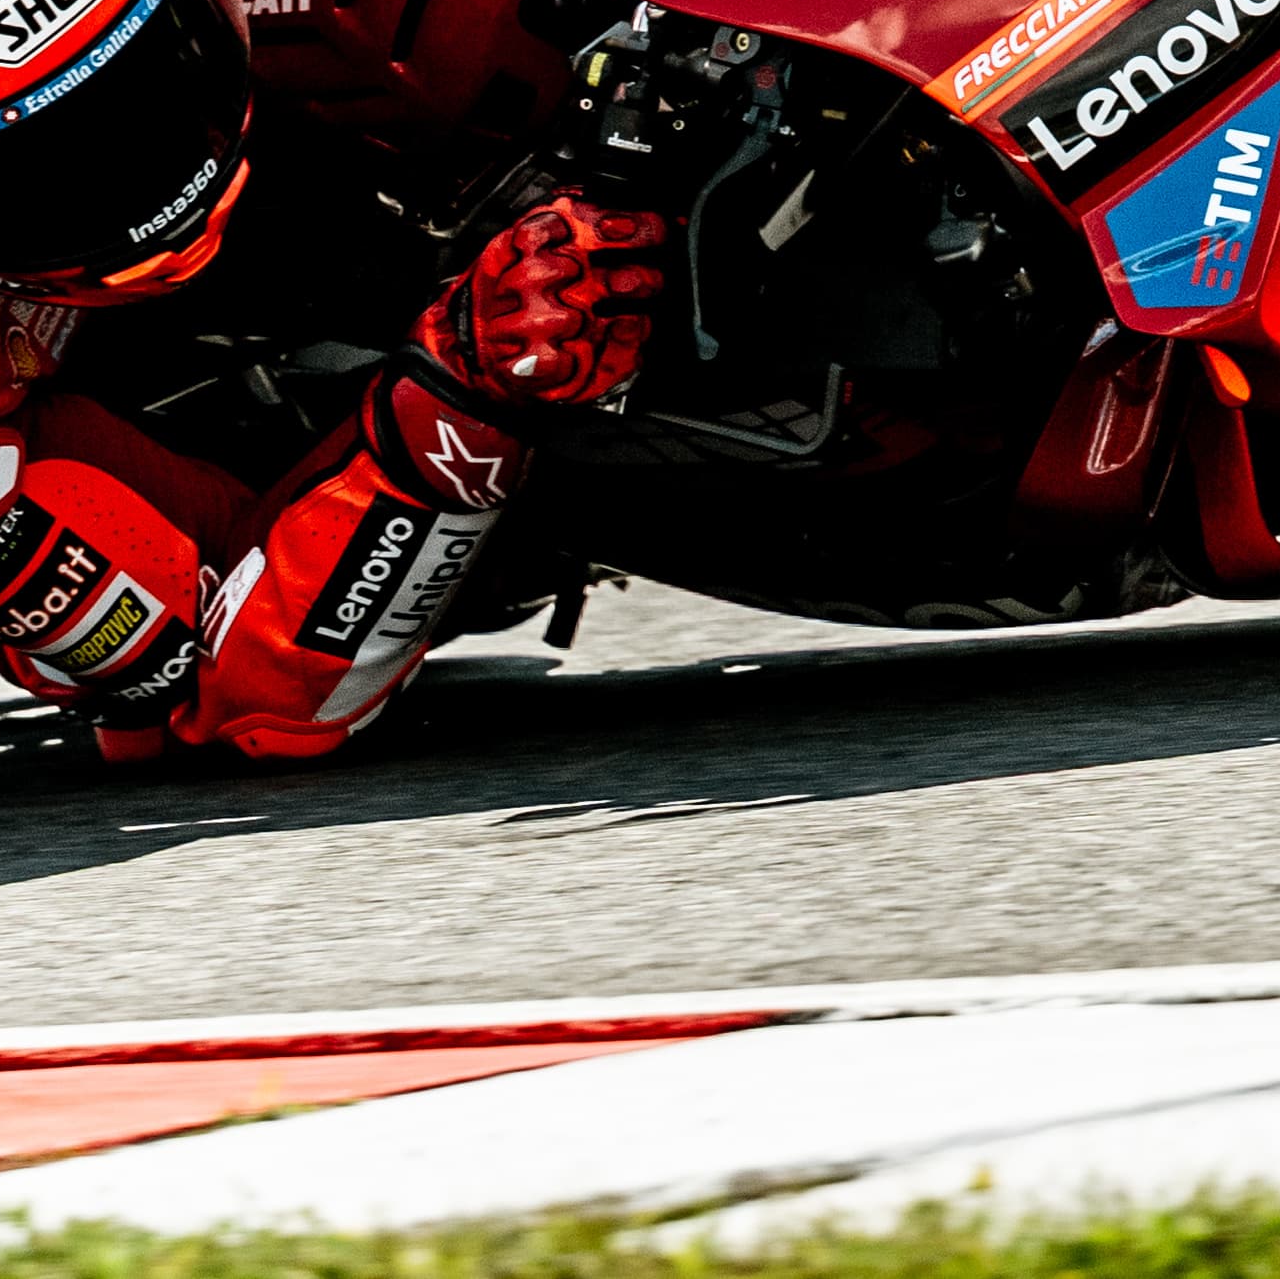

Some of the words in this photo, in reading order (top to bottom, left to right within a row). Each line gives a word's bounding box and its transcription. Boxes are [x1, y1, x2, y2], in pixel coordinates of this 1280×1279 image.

[24, 64, 93, 115] Estrella
[89, 14, 144, 67] Galicia
[127, 157, 219, 244] Insta360
[1202, 127, 1272, 228] TIM
[314, 514, 415, 643] Lenovo
[377, 526, 484, 640] Unipol
